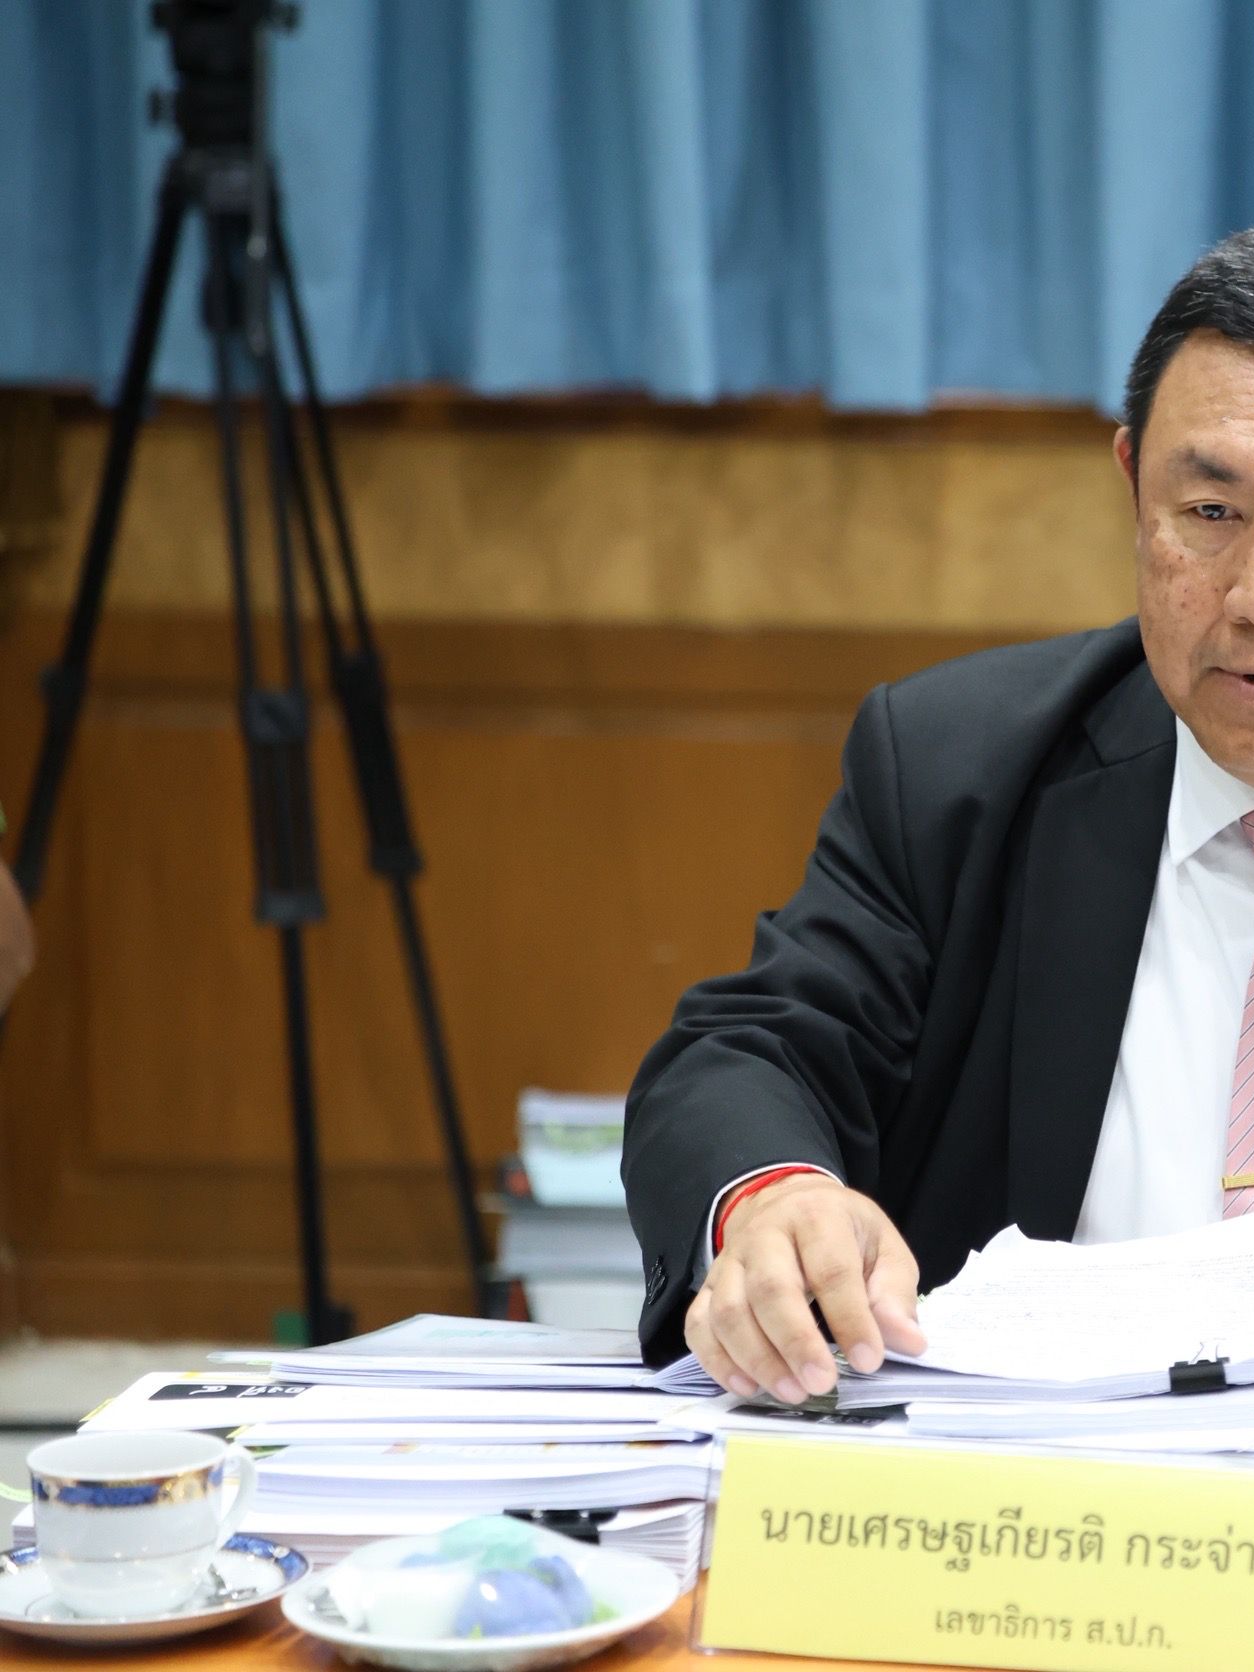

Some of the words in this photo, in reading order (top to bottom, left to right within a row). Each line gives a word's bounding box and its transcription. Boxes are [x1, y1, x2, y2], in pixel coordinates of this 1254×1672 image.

[761, 1506, 1106, 1573] นายเศรษฐเกียรติ
[934, 1602, 1073, 1642] เลขาธิการ
[1085, 1615, 1173, 1650] ส.ป.ก.
